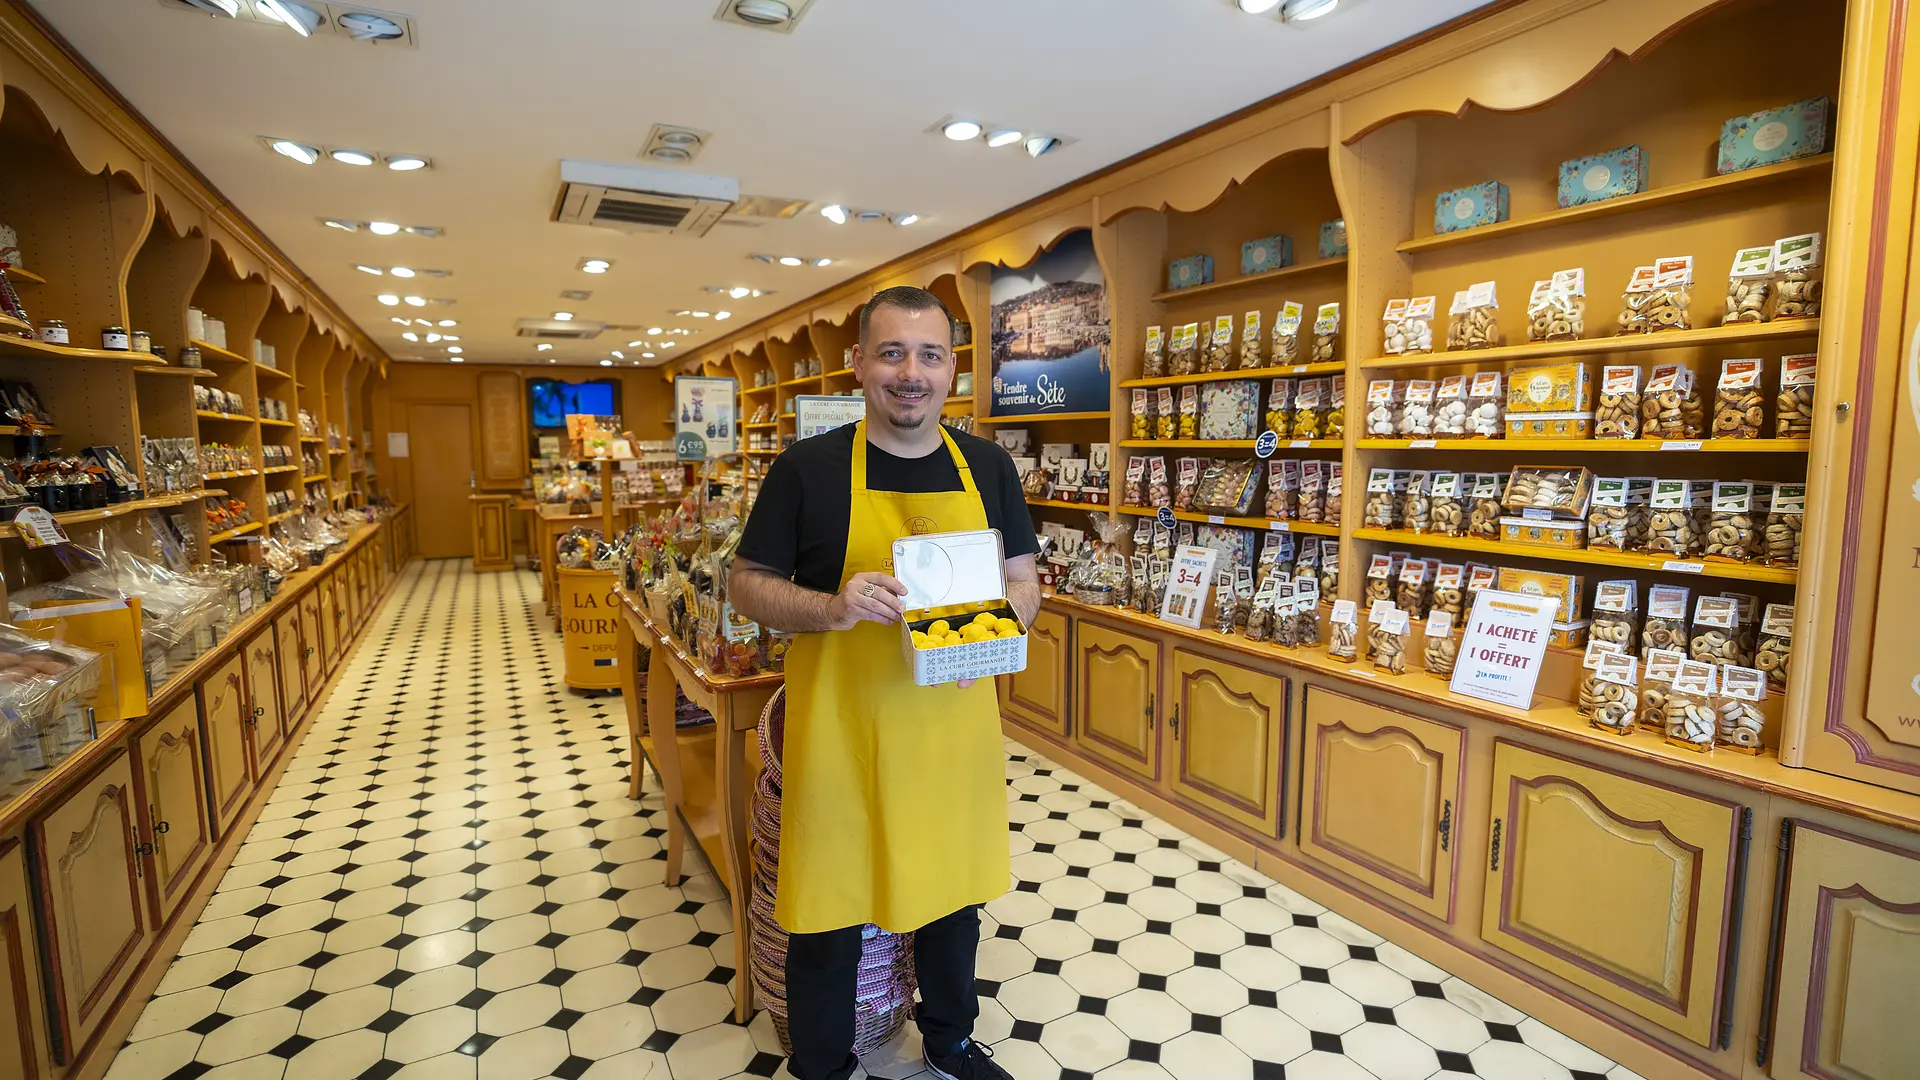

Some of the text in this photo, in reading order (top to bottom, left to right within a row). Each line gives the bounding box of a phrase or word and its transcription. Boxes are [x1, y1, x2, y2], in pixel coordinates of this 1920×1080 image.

[998, 374, 1066, 406] souvenir de Sète
[1003, 382, 1028, 394] Tendre
[804, 412, 820, 421] OFFRE
[1258, 438, 1276, 450] 3=4
[1178, 568, 1202, 586] 3=4
[574, 593, 597, 608] LA
[1477, 622, 1538, 644] 1 ACHETÉ
[966, 657, 1006, 667] GOURMANDE
[1470, 647, 1530, 669] 1 OFFERT
[1488, 672, 1508, 681] PROFITE
